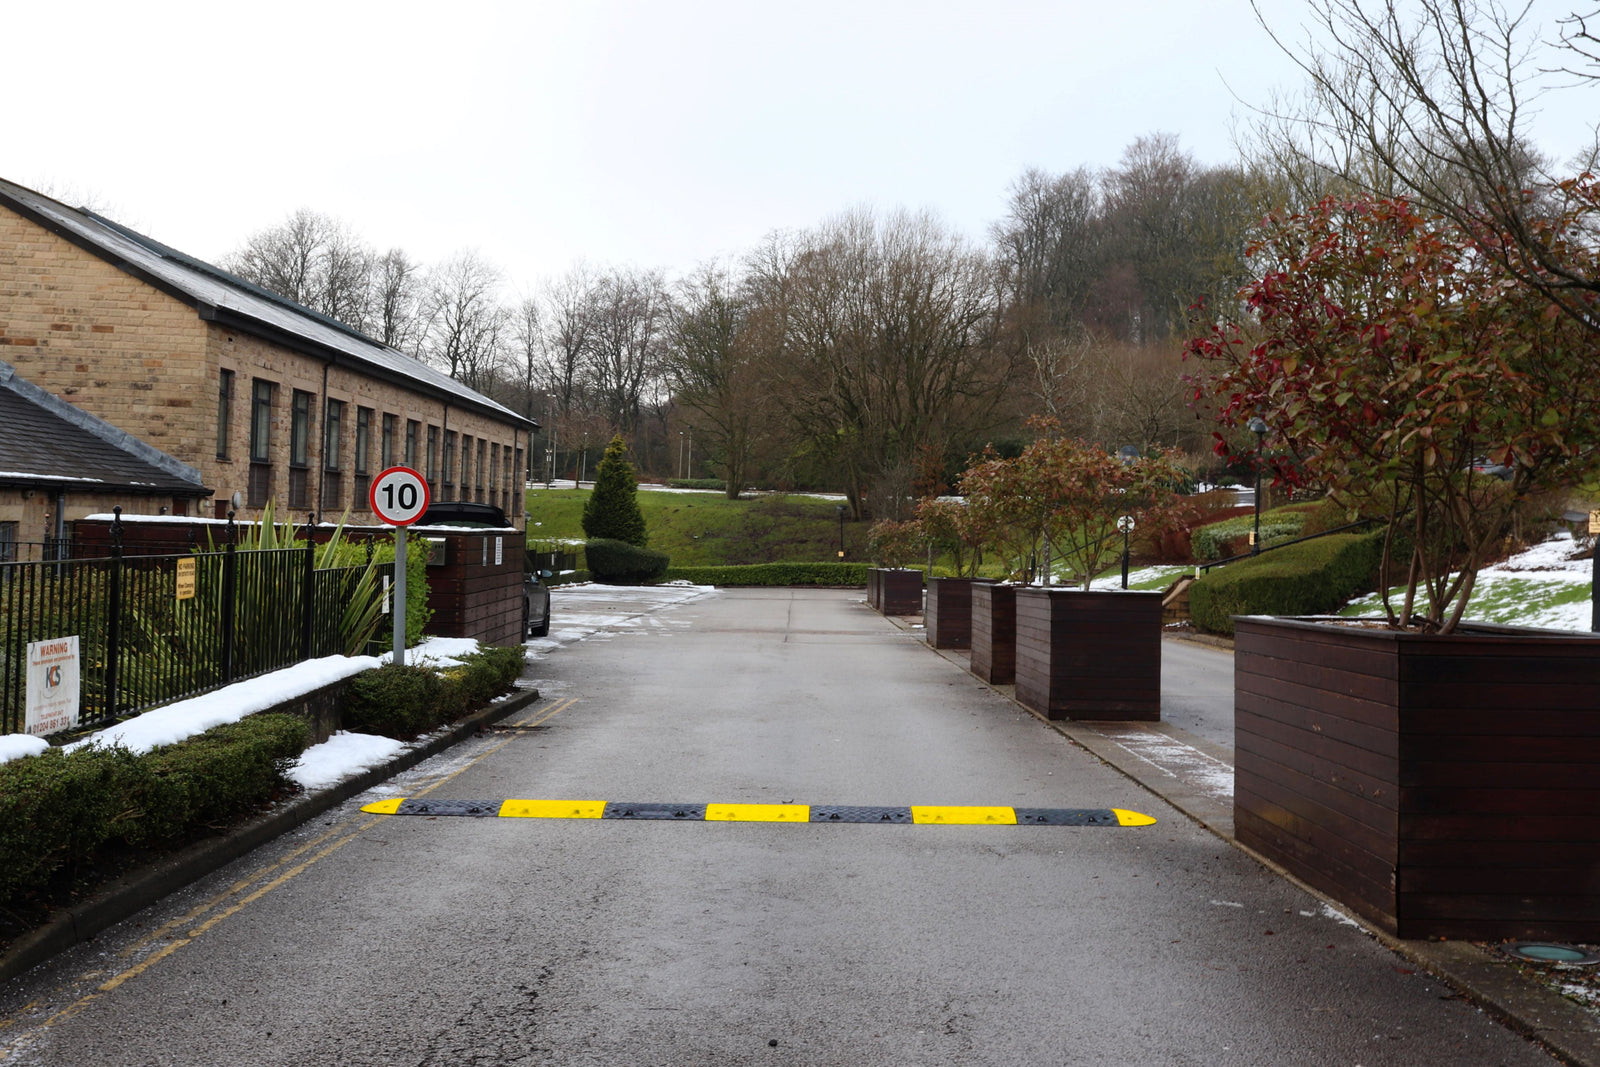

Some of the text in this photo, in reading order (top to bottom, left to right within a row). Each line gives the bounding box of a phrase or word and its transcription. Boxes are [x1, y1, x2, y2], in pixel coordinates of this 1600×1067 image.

[382, 483, 417, 510] 10
[40, 641, 68, 657] WARNING
[46, 665, 61, 688] KCS
